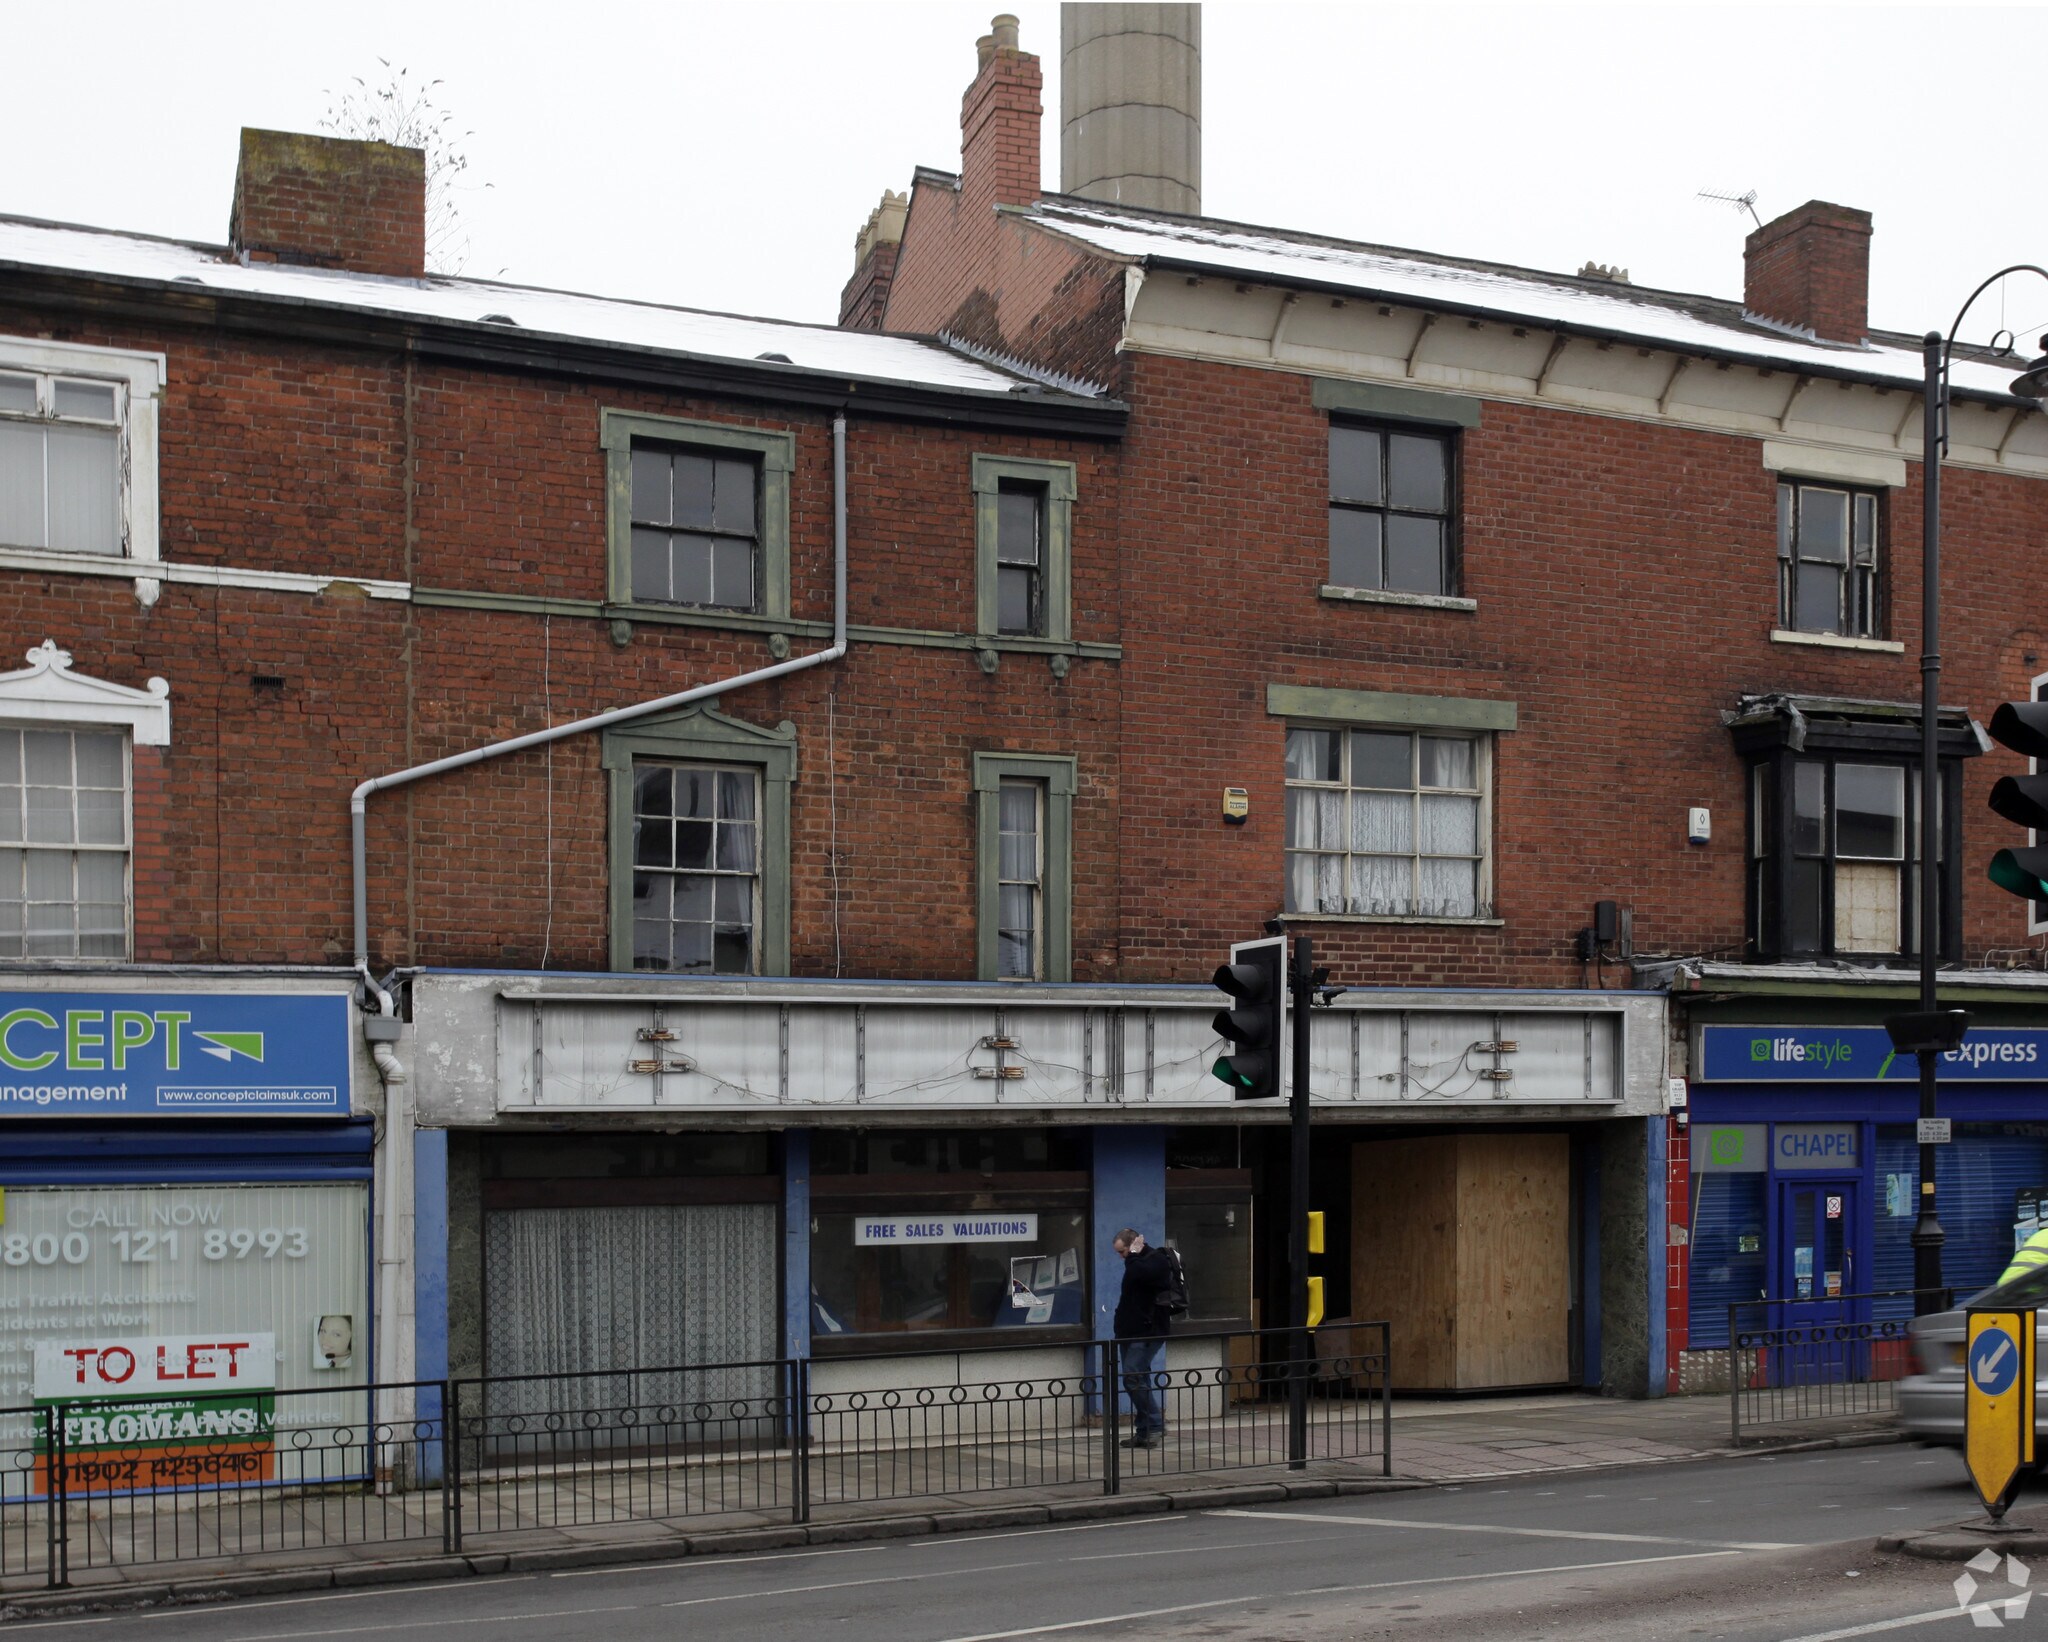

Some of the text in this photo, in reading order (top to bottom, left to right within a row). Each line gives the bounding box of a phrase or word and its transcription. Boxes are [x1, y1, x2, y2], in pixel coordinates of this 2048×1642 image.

[1773, 1037, 2037, 1069] lifestyle express
[0, 1083, 127, 1105] nagement
[163, 1089, 331, 1102] www.conceptclaimsuk.com
[1780, 1132, 1857, 1157] CHAPEL
[66, 1202, 223, 1229] CALL NOW
[866, 1222, 1027, 1238] FREE SALES VALUATIONS
[0, 1226, 310, 1267] 800 121 8993
[29, 1291, 94, 1307] Traffic
[100, 1290, 195, 1305] Accidents
[75, 1314, 96, 1328] at
[102, 1310, 152, 1327] Work
[64, 1342, 249, 1383] TO LET
[264, 1411, 342, 1426] Vehicles
[52, 1458, 139, 1485] 01902
[151, 1452, 259, 1478] 425646
